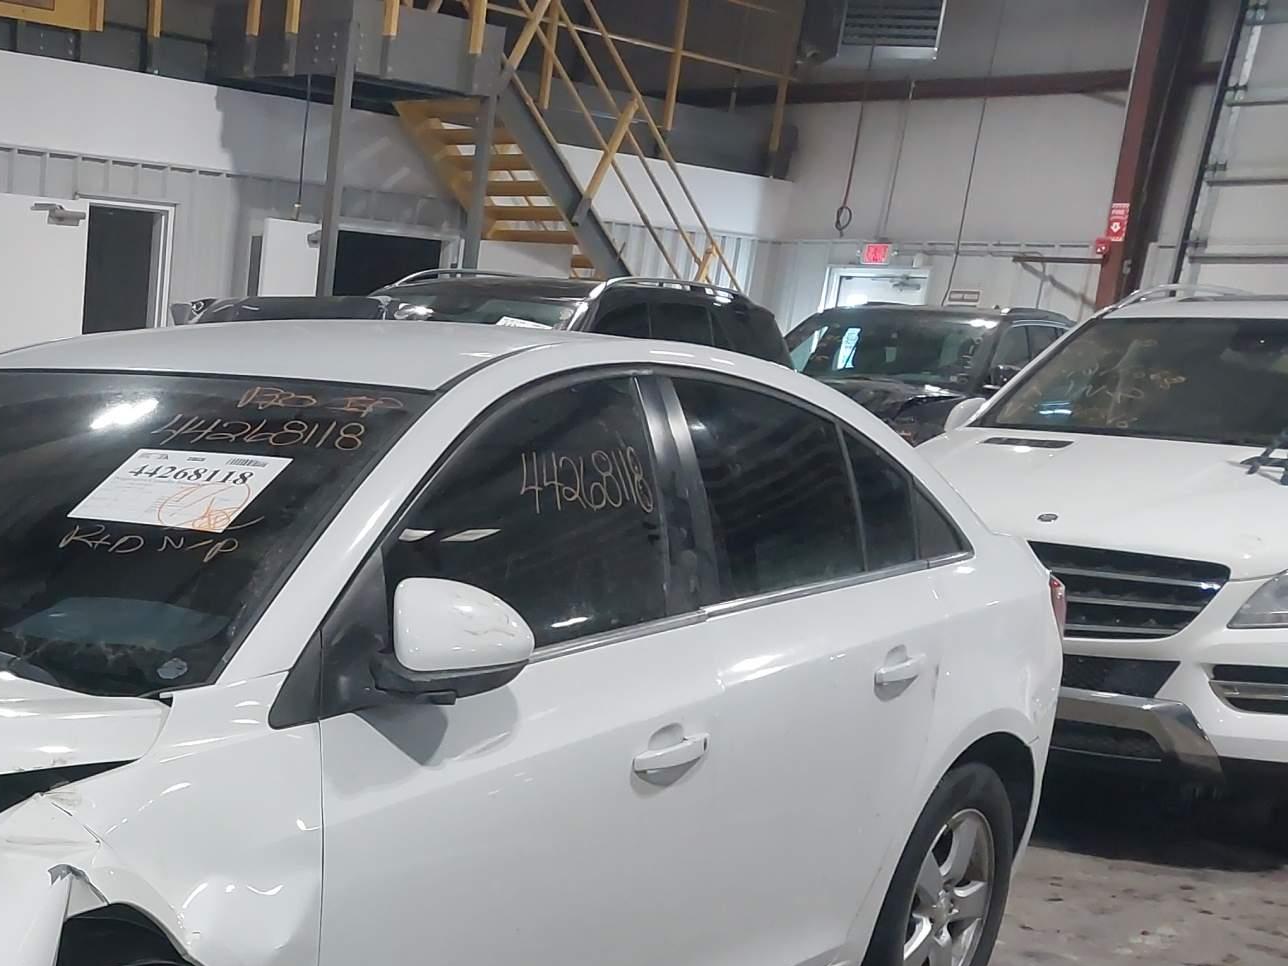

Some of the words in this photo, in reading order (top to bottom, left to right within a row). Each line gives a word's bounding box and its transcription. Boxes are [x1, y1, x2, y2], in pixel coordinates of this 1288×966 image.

[151, 412, 366, 451] 44268118
[128, 463, 255, 486] 44268118
[519, 446, 654, 514] 44268118
